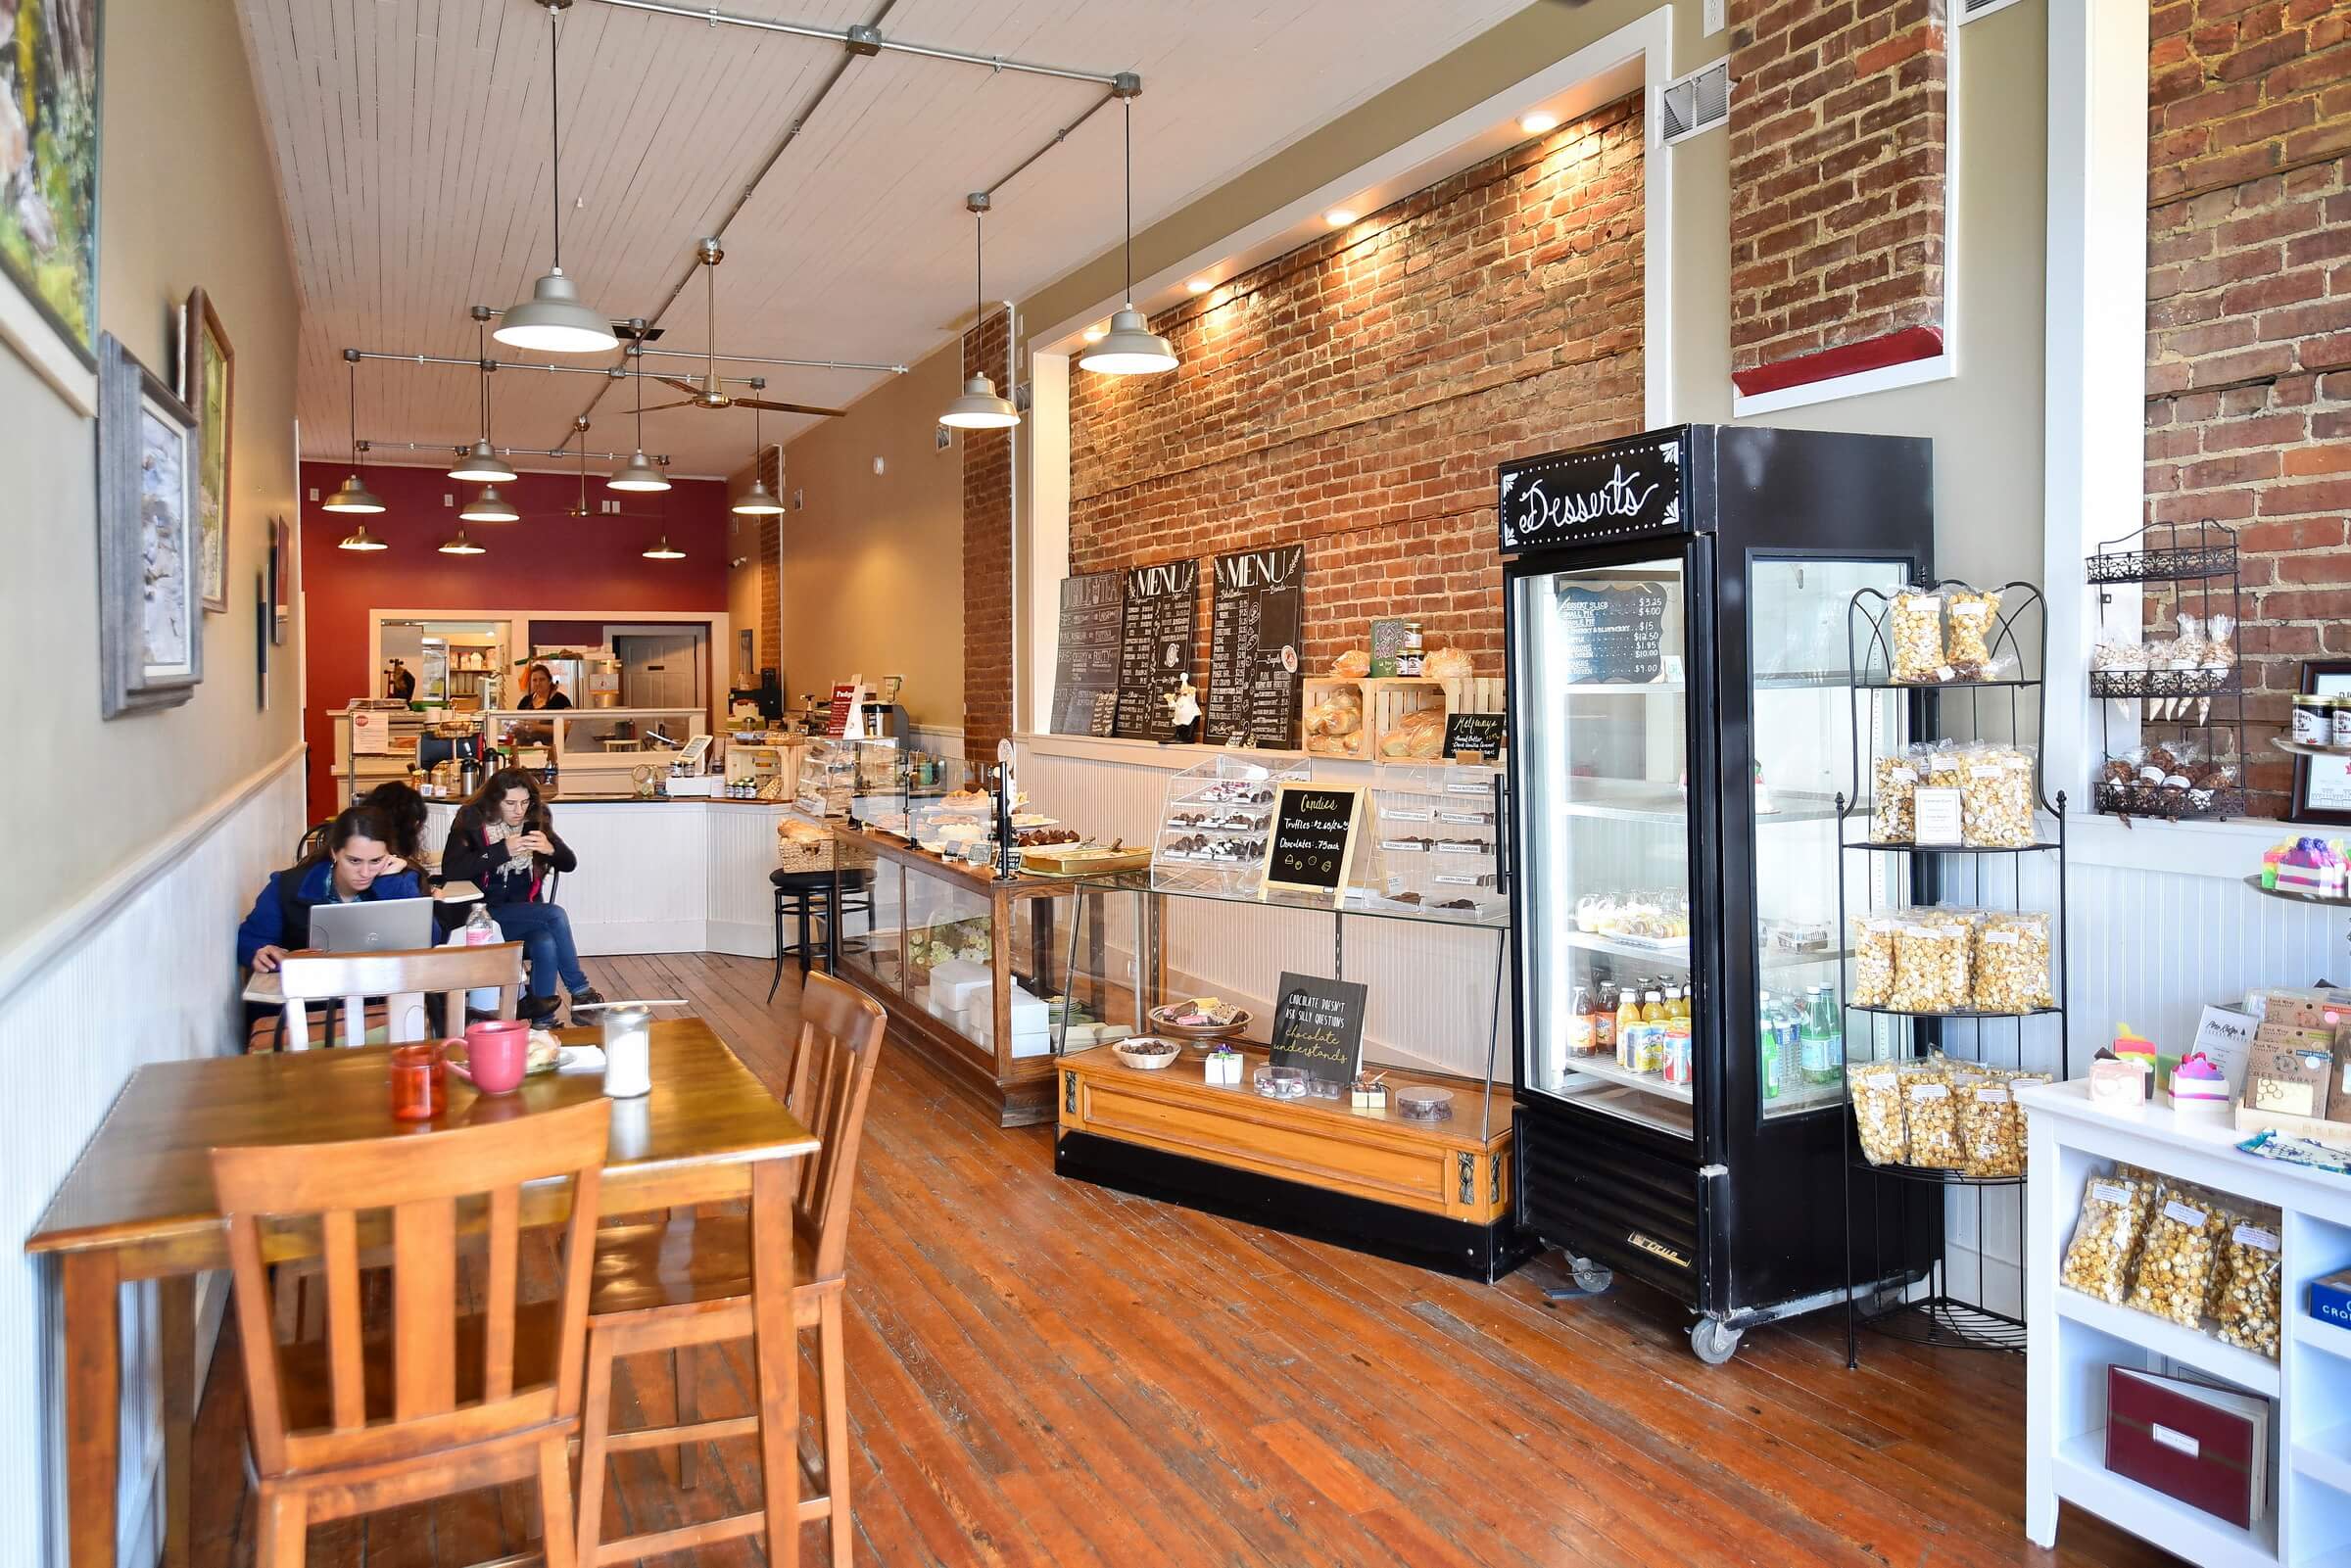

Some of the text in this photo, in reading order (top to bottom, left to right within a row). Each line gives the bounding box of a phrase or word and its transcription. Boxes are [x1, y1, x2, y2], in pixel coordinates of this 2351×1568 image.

[1519, 464, 1658, 534] Desserts
[1225, 550, 1286, 589] MENU
[1136, 564, 1185, 598] MENU
[1639, 621, 1655, 632] $15
[1633, 632, 1658, 641] $12.50
[1635, 649, 1658, 658] $10.00
[1633, 664, 1657, 674] $9.00
[1301, 794, 1338, 812] Candies
[1289, 994, 1345, 1013] CHOCOLATE DOESN'T
[1285, 1008, 1344, 1028] ASK SILLY QUESTIONS
[1285, 1024, 1340, 1045] chocolate
[2322, 1304, 2351, 1322] CRO
